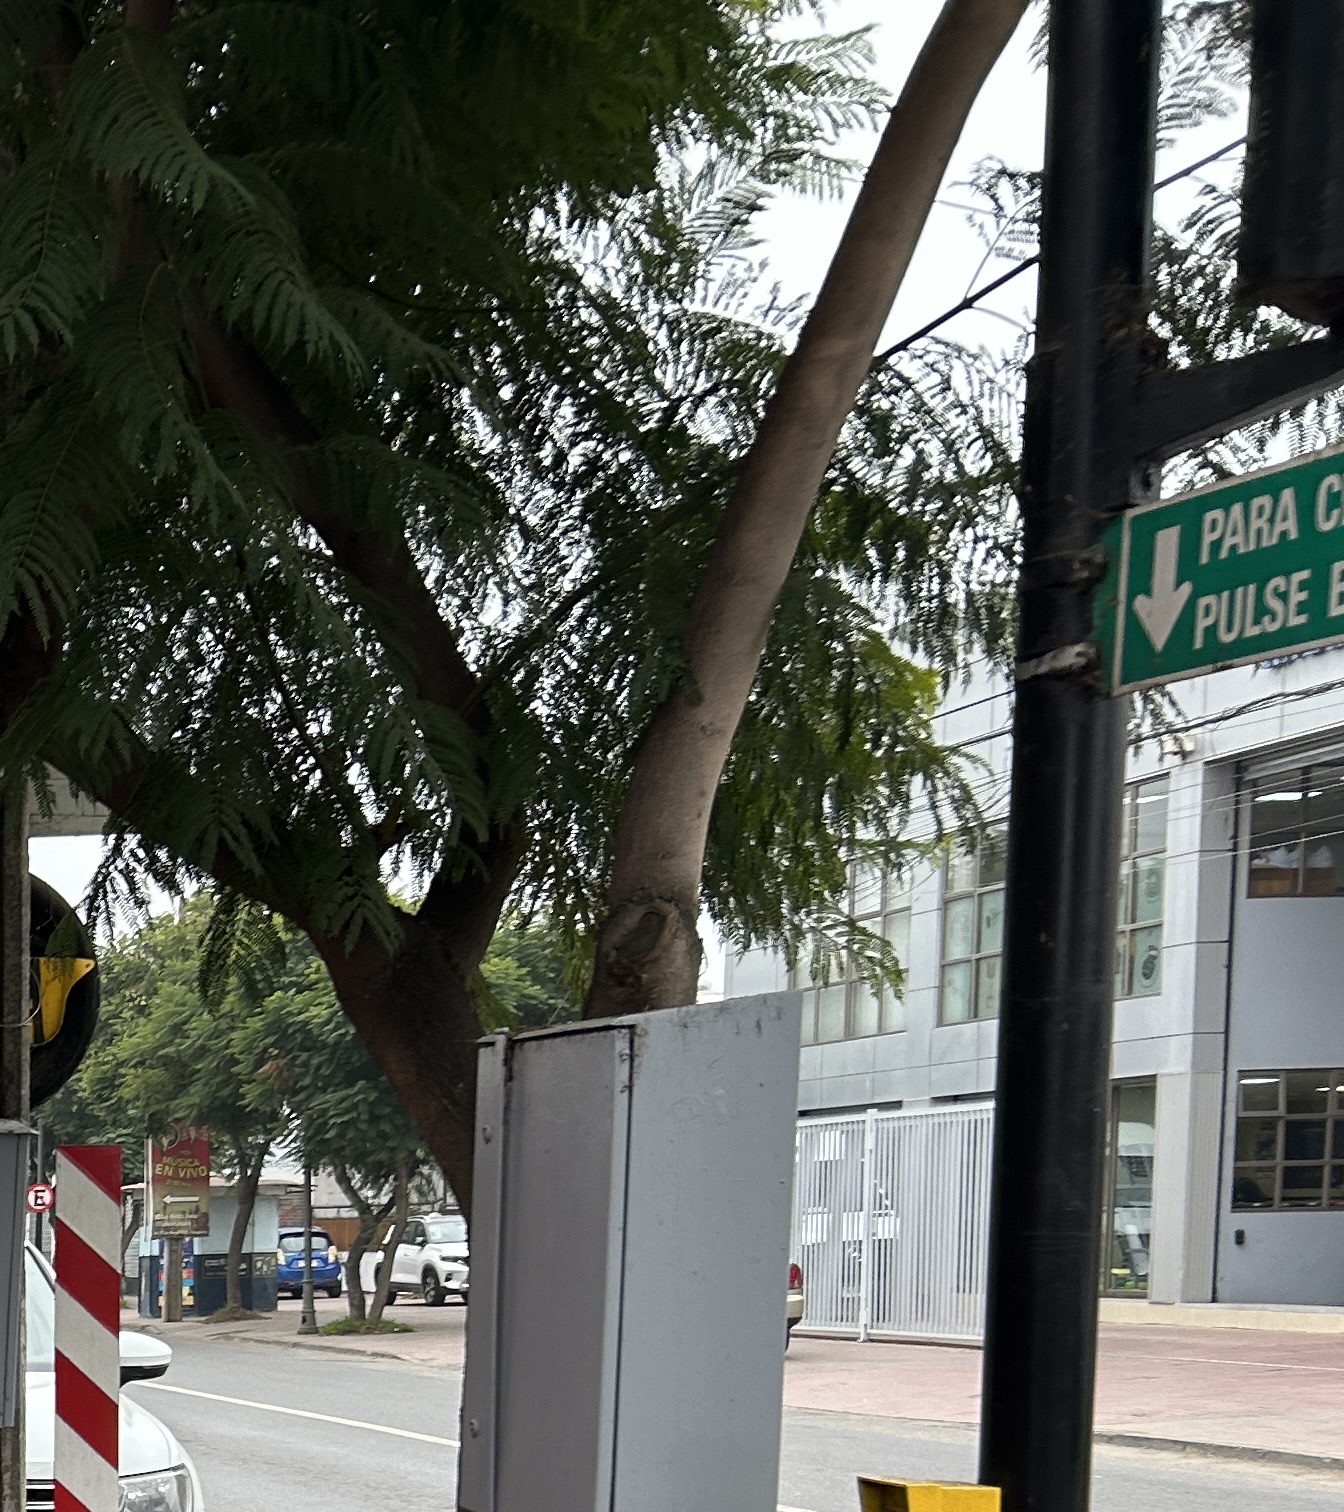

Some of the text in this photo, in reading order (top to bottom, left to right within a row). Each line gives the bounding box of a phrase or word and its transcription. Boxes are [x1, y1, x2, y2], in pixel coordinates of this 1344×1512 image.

[1199, 473, 1344, 566] PARA C
[1193, 568, 1312, 650] PULSE
[154, 1163, 208, 1179] EN VIVO
